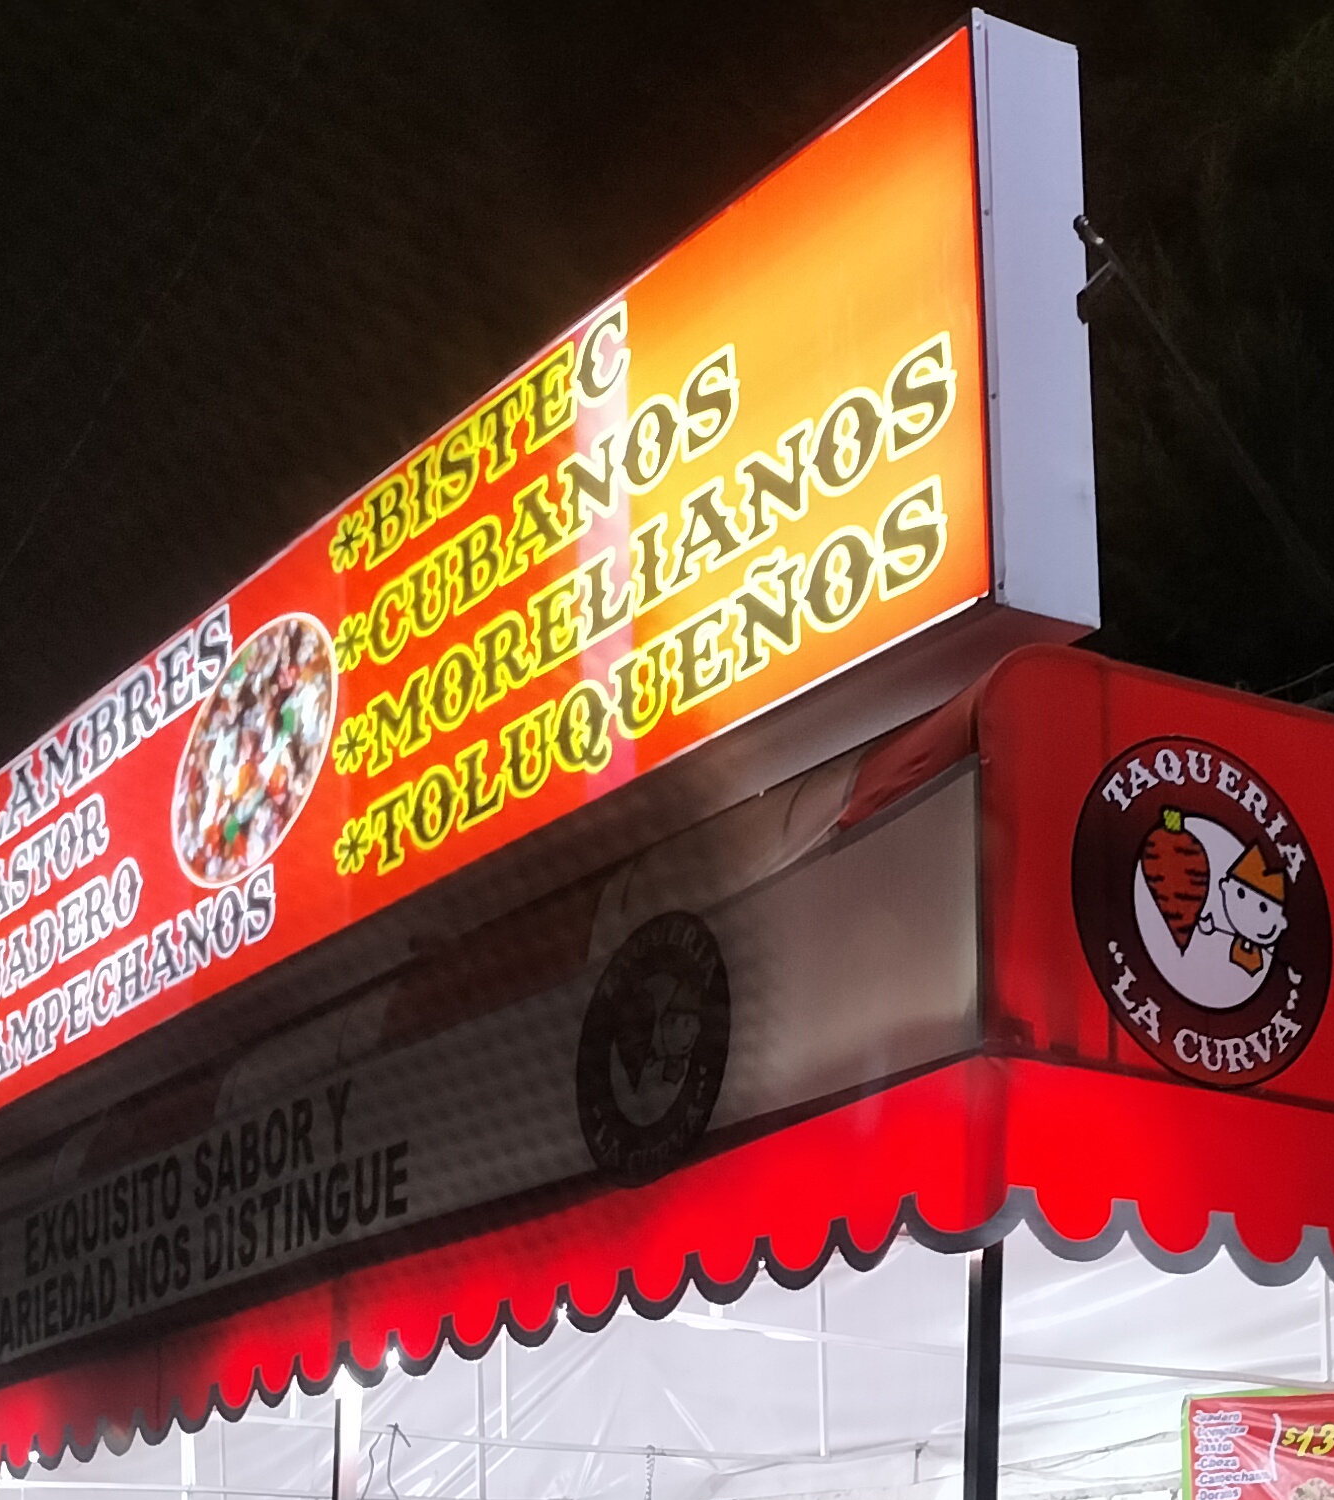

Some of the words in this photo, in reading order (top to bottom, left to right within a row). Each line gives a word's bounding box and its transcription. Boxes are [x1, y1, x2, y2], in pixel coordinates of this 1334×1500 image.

[1101, 746, 1308, 884] TAQUERIA
[24, 1161, 182, 1278] EXQUISITO
[193, 1107, 316, 1209] SABOR
[325, 1079, 357, 1165] Y
[126, 1238, 191, 1307] NOS
[202, 1140, 409, 1280] DISTINGUE
